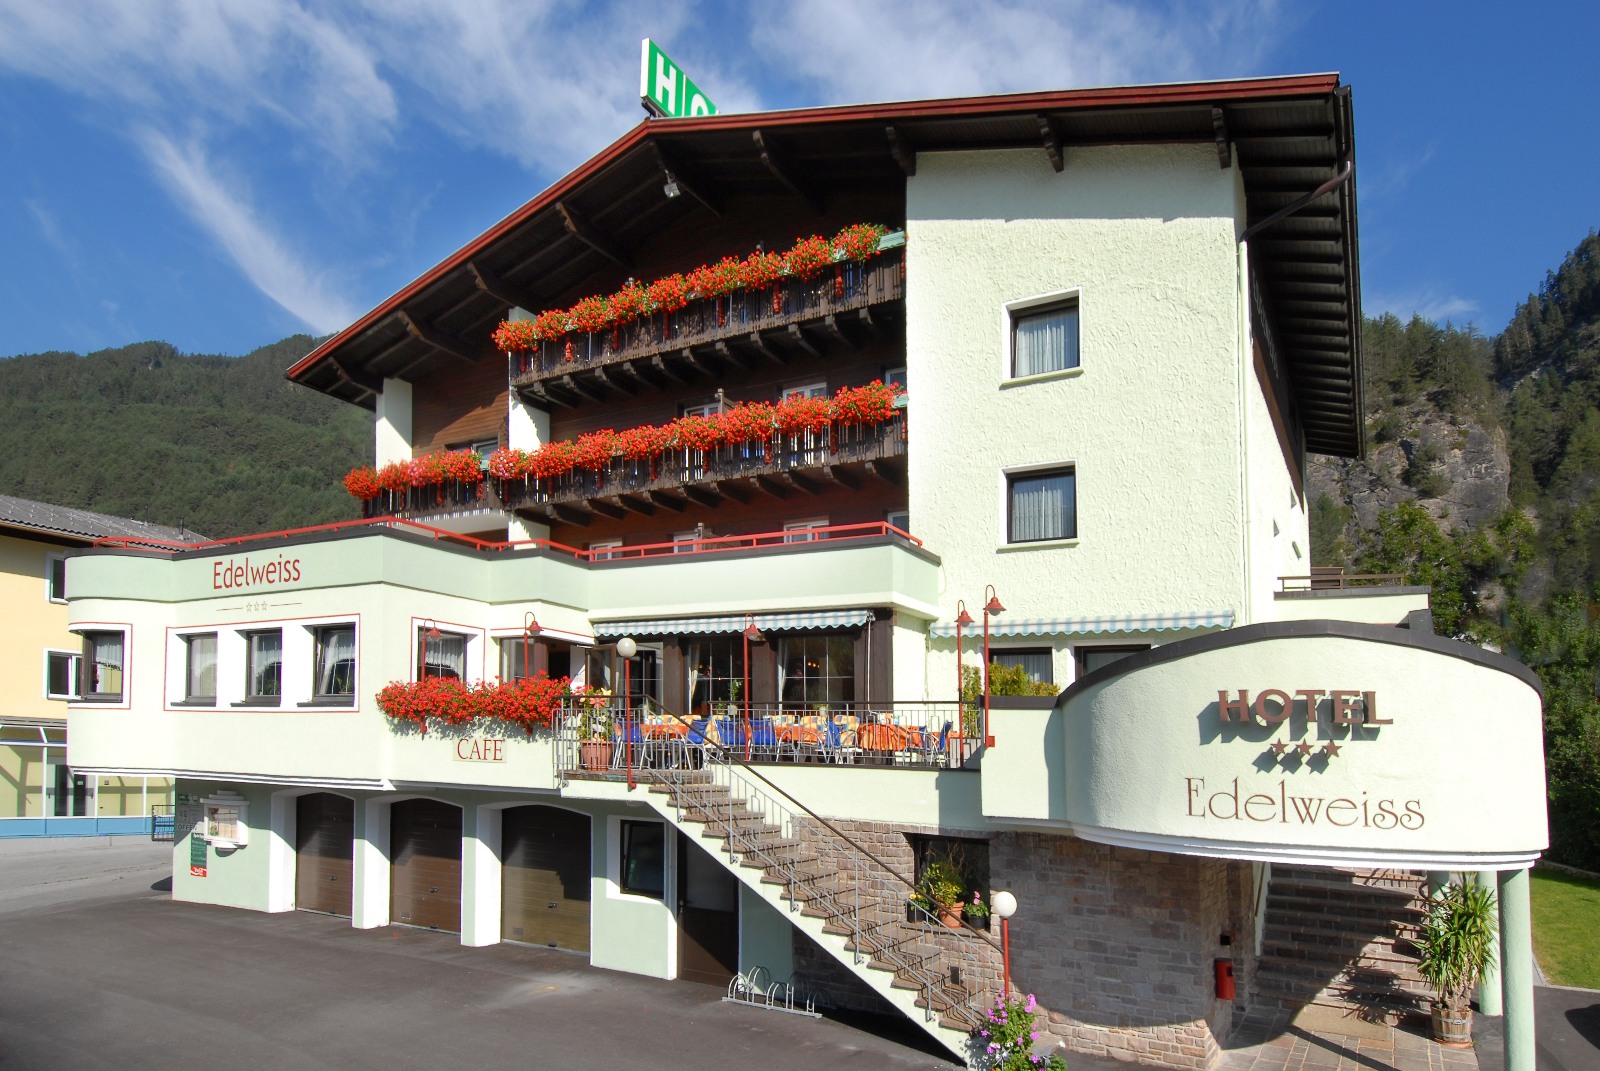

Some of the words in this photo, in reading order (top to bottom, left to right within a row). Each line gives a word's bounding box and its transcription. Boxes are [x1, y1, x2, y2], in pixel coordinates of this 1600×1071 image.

[213, 553, 301, 590] Edelweiss
[1217, 688, 1394, 725] HOTEL
[457, 738, 504, 761] CAFE
[1185, 775, 1425, 831] Edelweiss
